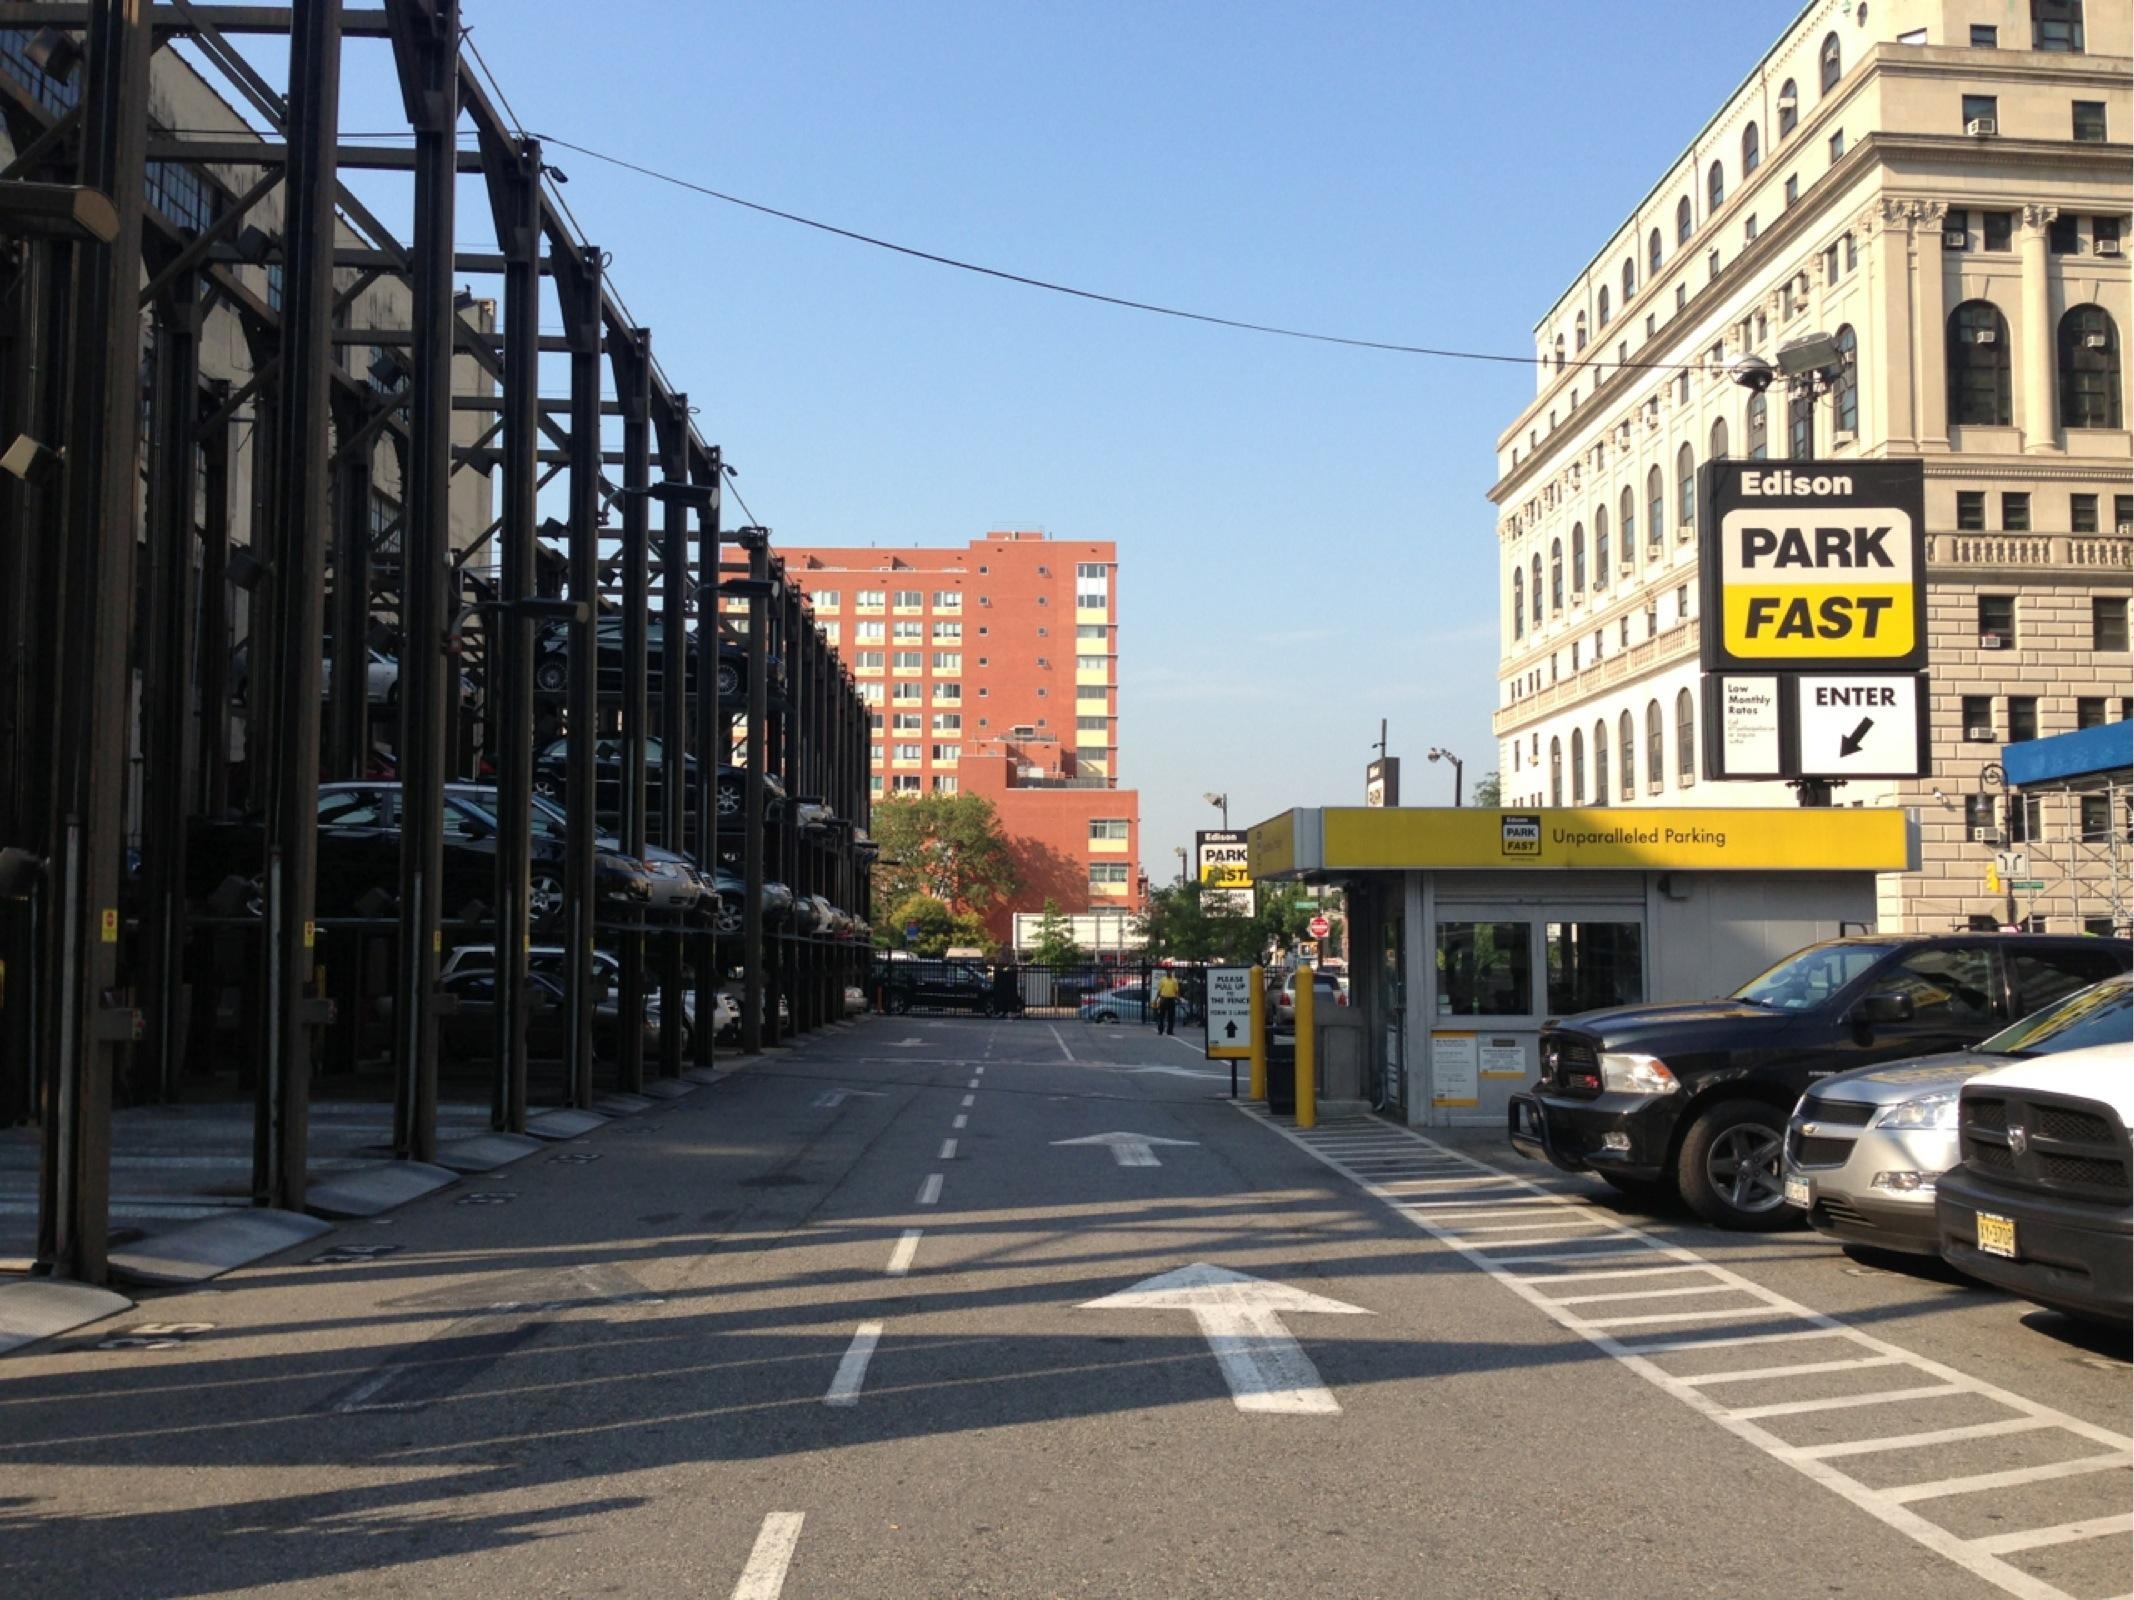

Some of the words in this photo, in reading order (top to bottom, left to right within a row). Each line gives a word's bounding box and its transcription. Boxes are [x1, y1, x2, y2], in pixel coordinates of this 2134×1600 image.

[1741, 471, 1853, 496] Edison
[1741, 527, 1895, 569] PARK
[1744, 596, 1894, 639] FAST
[1728, 683, 1749, 693] Low
[1728, 694, 1771, 707] Monthly
[1815, 687, 1897, 707] ENTER
[1728, 705, 1758, 715] Rates
[1205, 832, 1238, 841] Edison
[1506, 827, 1536, 837] PARK
[1552, 827, 1659, 847] Unparalleled
[1665, 827, 1726, 848] Parking
[1507, 841, 1536, 851] FAST
[1206, 849, 1248, 861] PARK
[1214, 983, 1232, 991] PULL
[1234, 983, 1246, 991] UP
[1211, 996, 1224, 1004] THE
